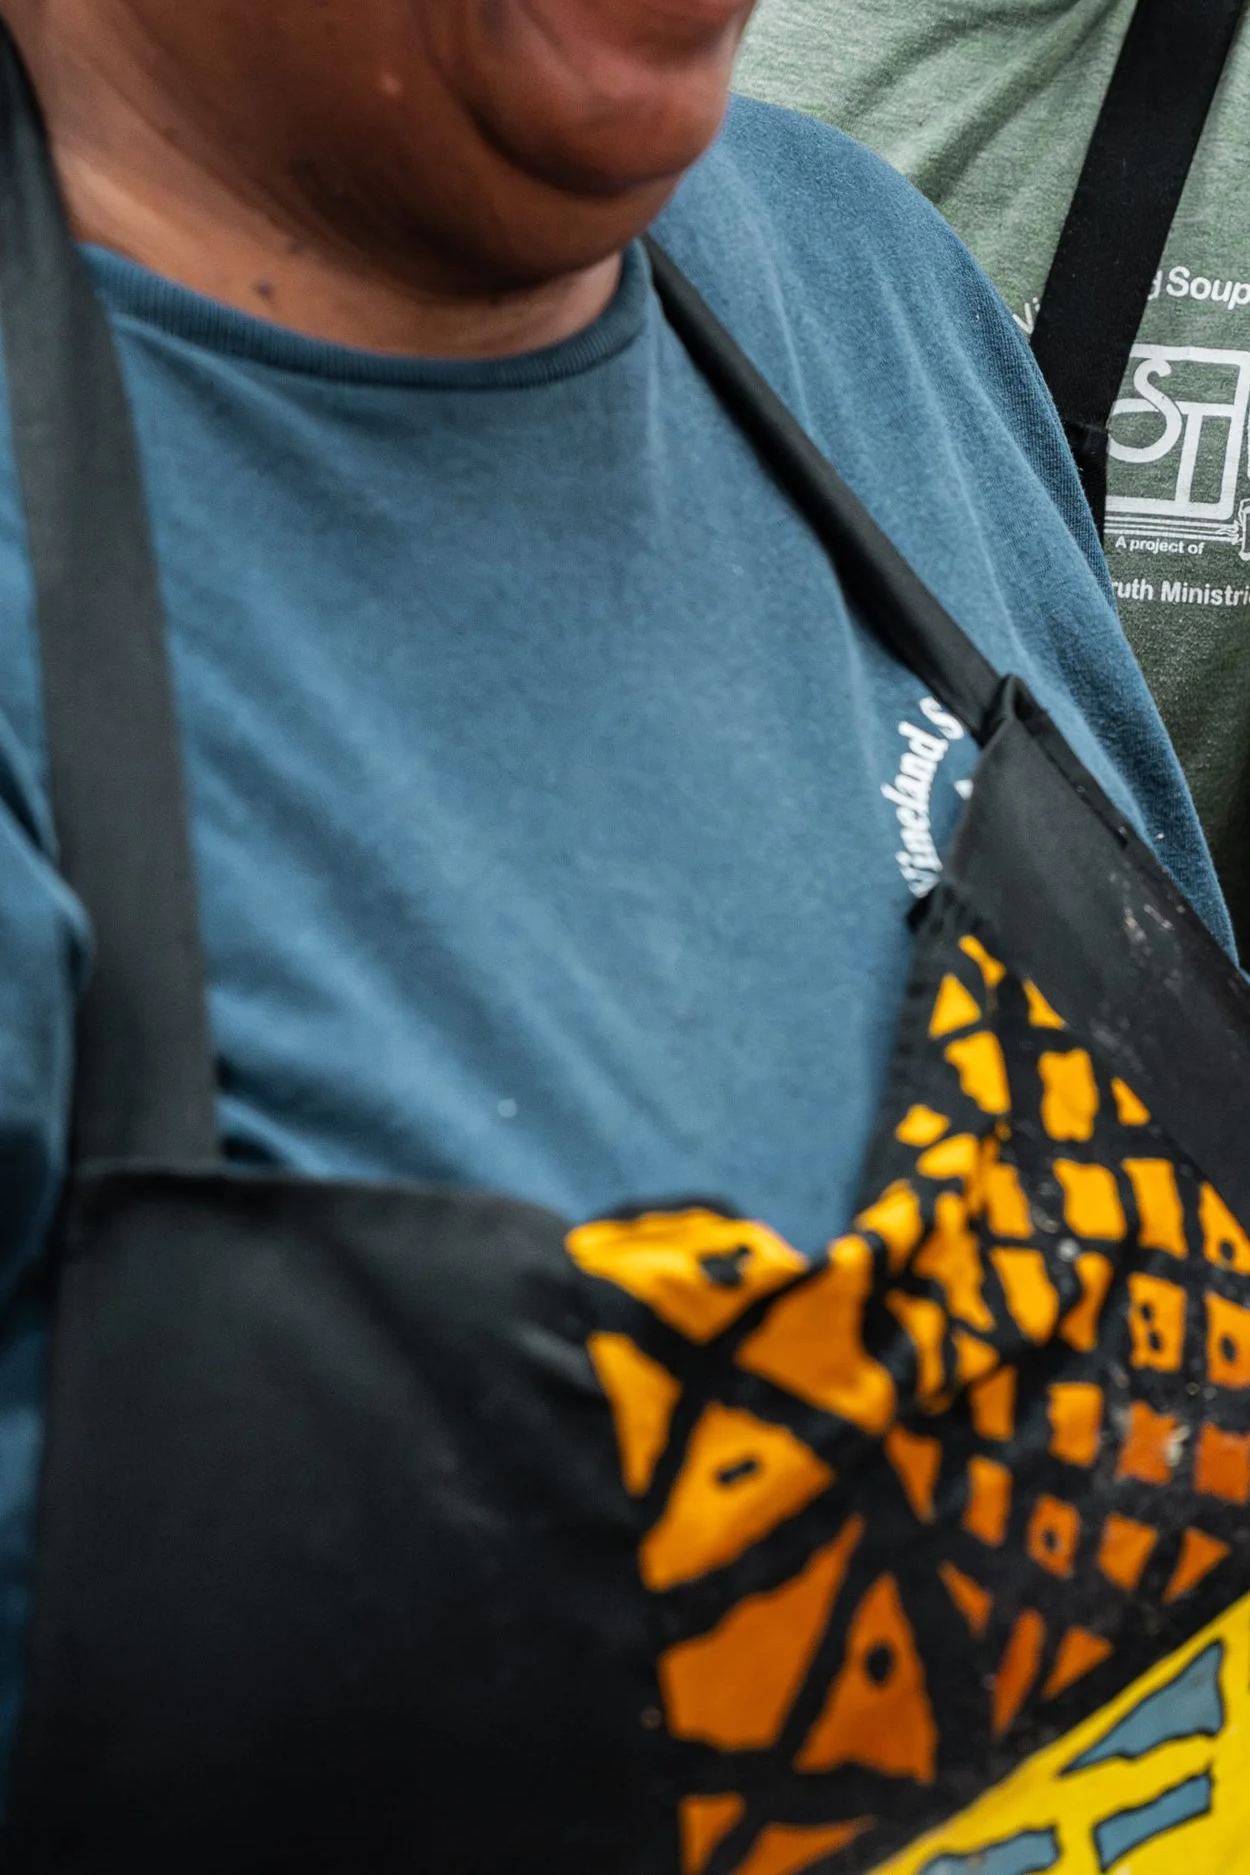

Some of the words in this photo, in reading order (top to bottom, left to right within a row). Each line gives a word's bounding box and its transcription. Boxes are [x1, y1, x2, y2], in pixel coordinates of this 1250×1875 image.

[1115, 536, 1127, 549] A
[1129, 538, 1184, 555] project
[1187, 542, 1205, 555] of
